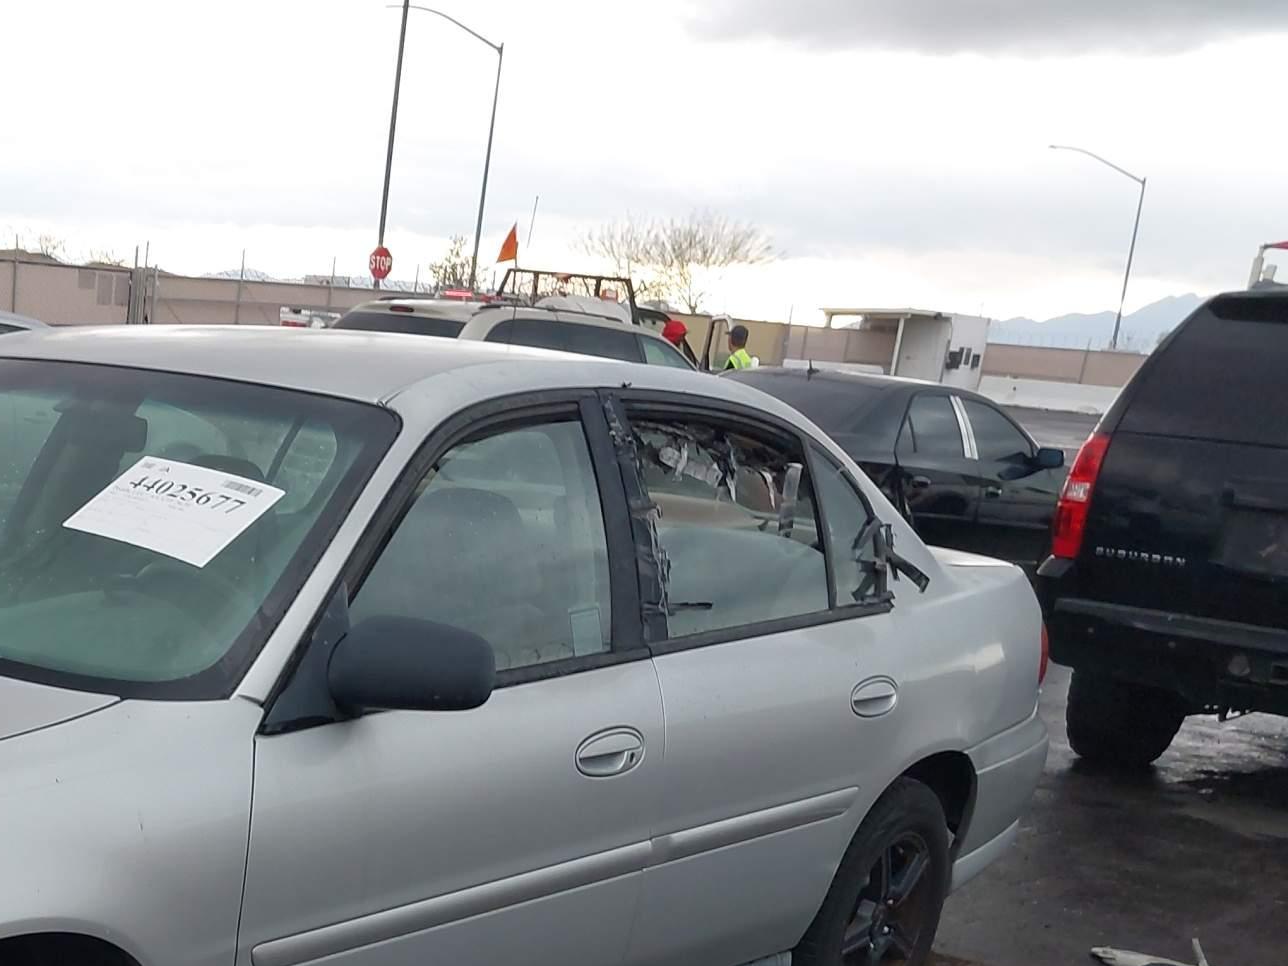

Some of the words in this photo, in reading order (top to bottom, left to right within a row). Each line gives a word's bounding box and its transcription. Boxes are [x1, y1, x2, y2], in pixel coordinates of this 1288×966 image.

[370, 254, 392, 272] STOP
[129, 475, 247, 514] 44025677
[1095, 546, 1187, 568] SUBURBAN
